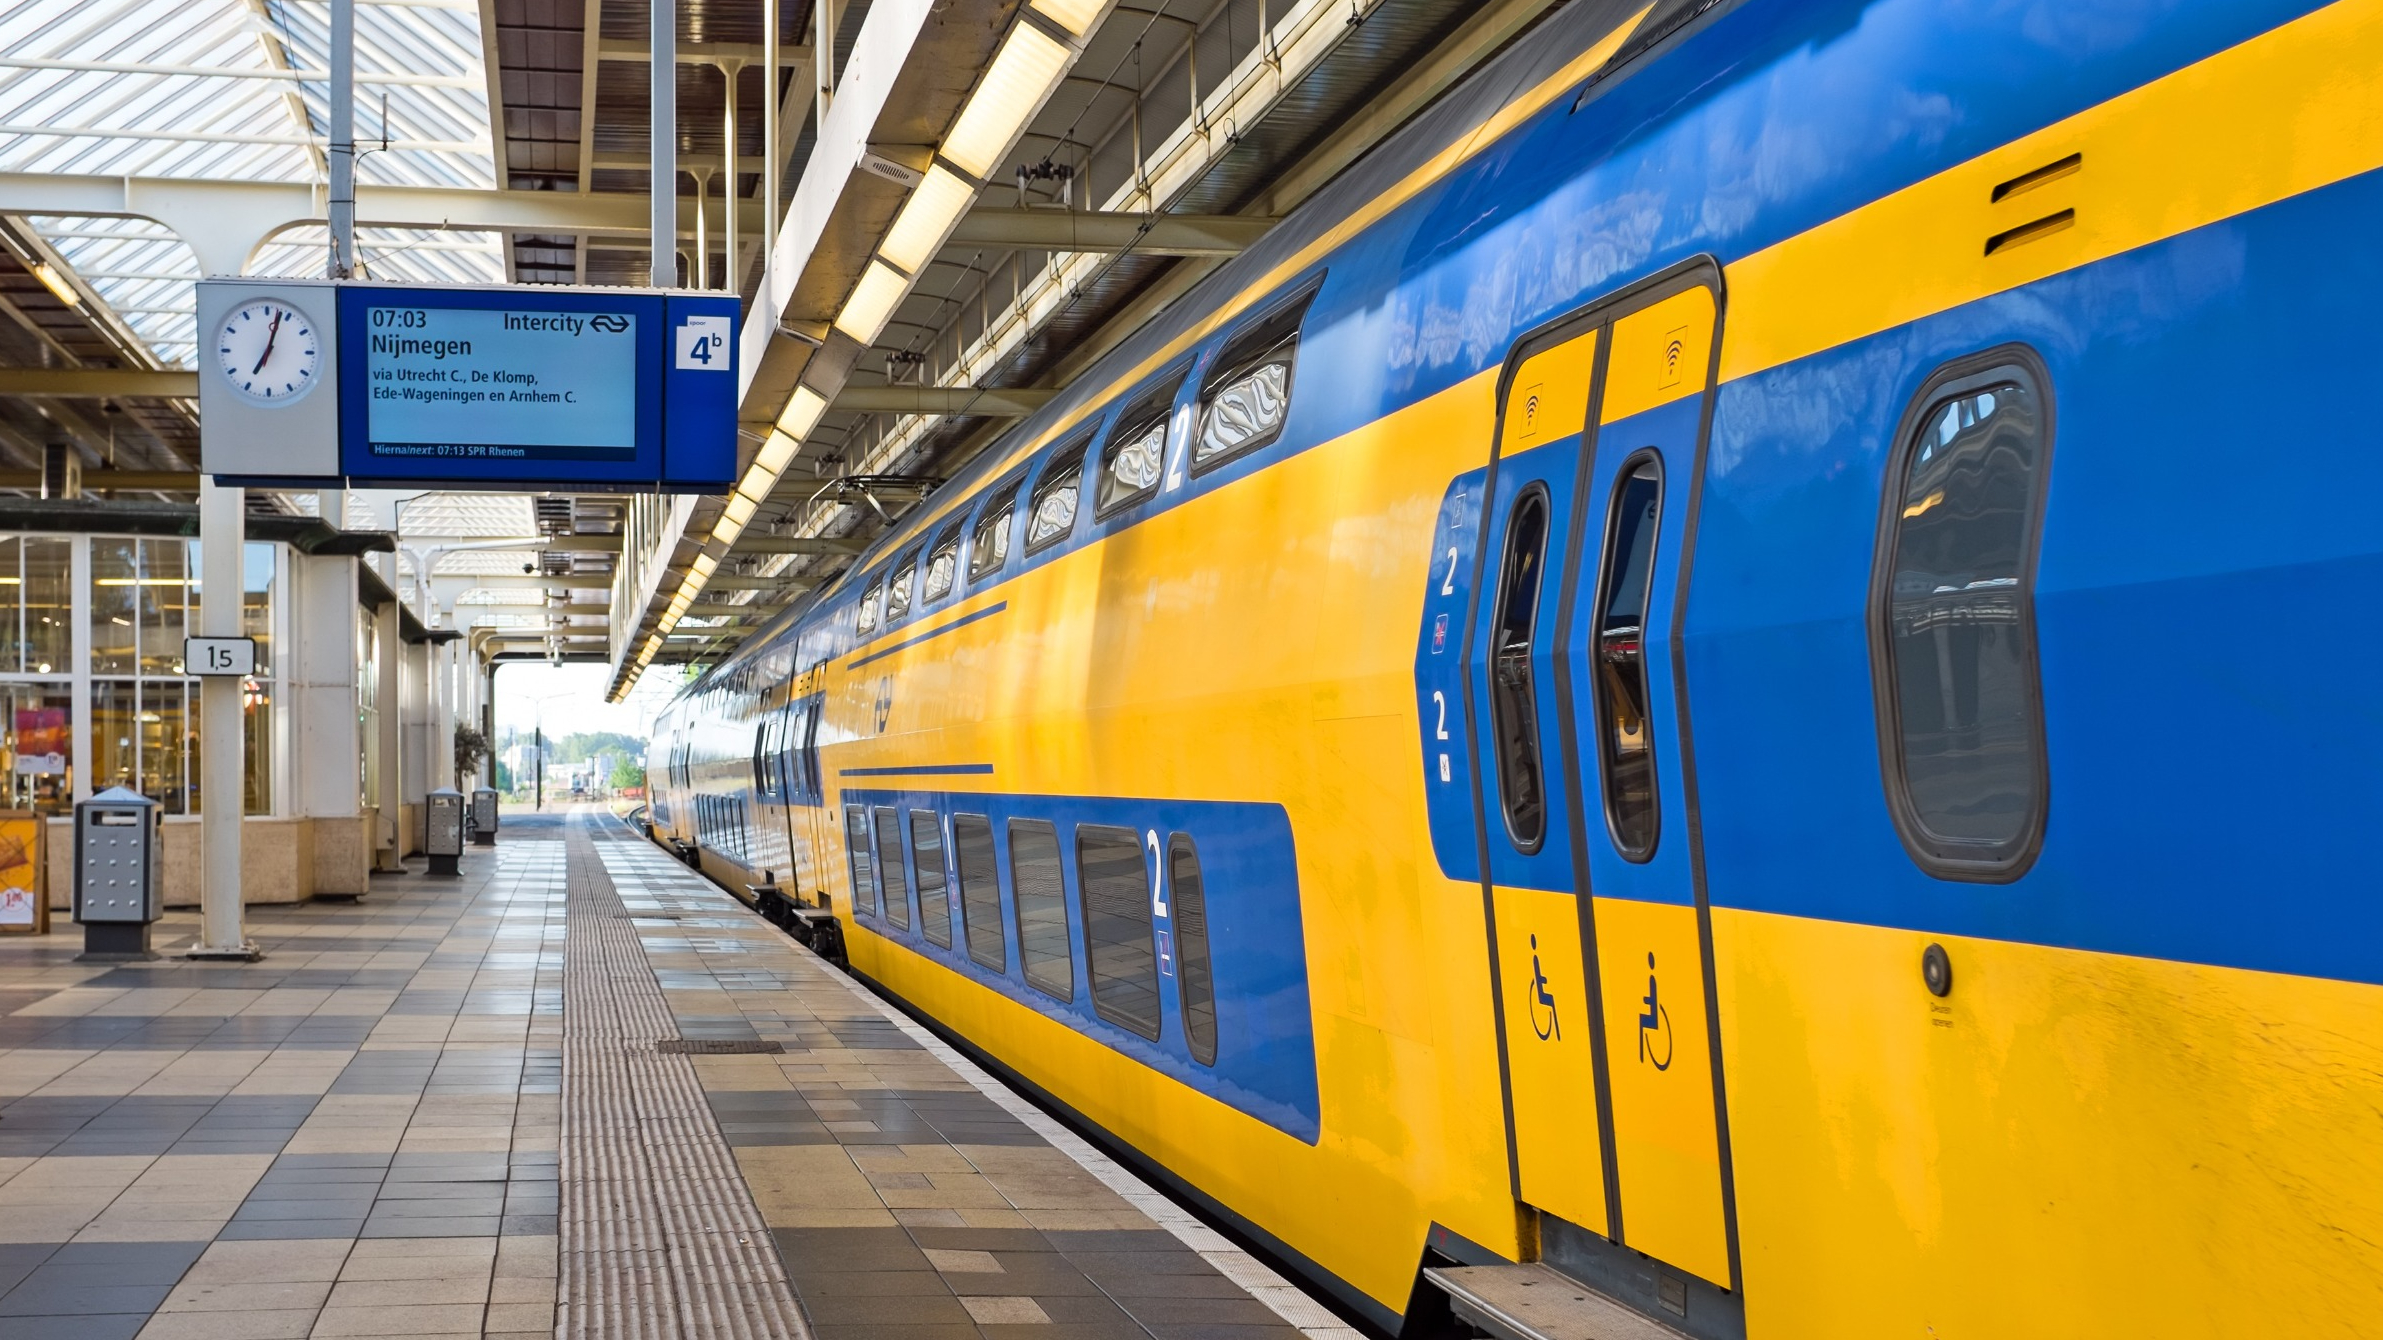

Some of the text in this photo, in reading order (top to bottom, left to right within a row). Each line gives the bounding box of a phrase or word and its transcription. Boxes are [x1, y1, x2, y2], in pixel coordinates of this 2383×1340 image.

[373, 309, 427, 328] 07:03
[504, 313, 584, 337] Intercity
[372, 334, 472, 360] Nijmegen
[373, 368, 538, 387] via Utrecht C., De Klomp,
[373, 386, 577, 404] Ede-Wageningen en Arnhem C.
[437, 445, 465, 456] 07:13
[468, 446, 486, 456] SPR
[488, 446, 525, 457] Rhenen
[1165, 403, 1191, 493] 2
[1441, 546, 1458, 596] 2
[207, 645, 233, 671] 1,5
[1433, 690, 1449, 740] 2
[1147, 829, 1168, 918] 2
